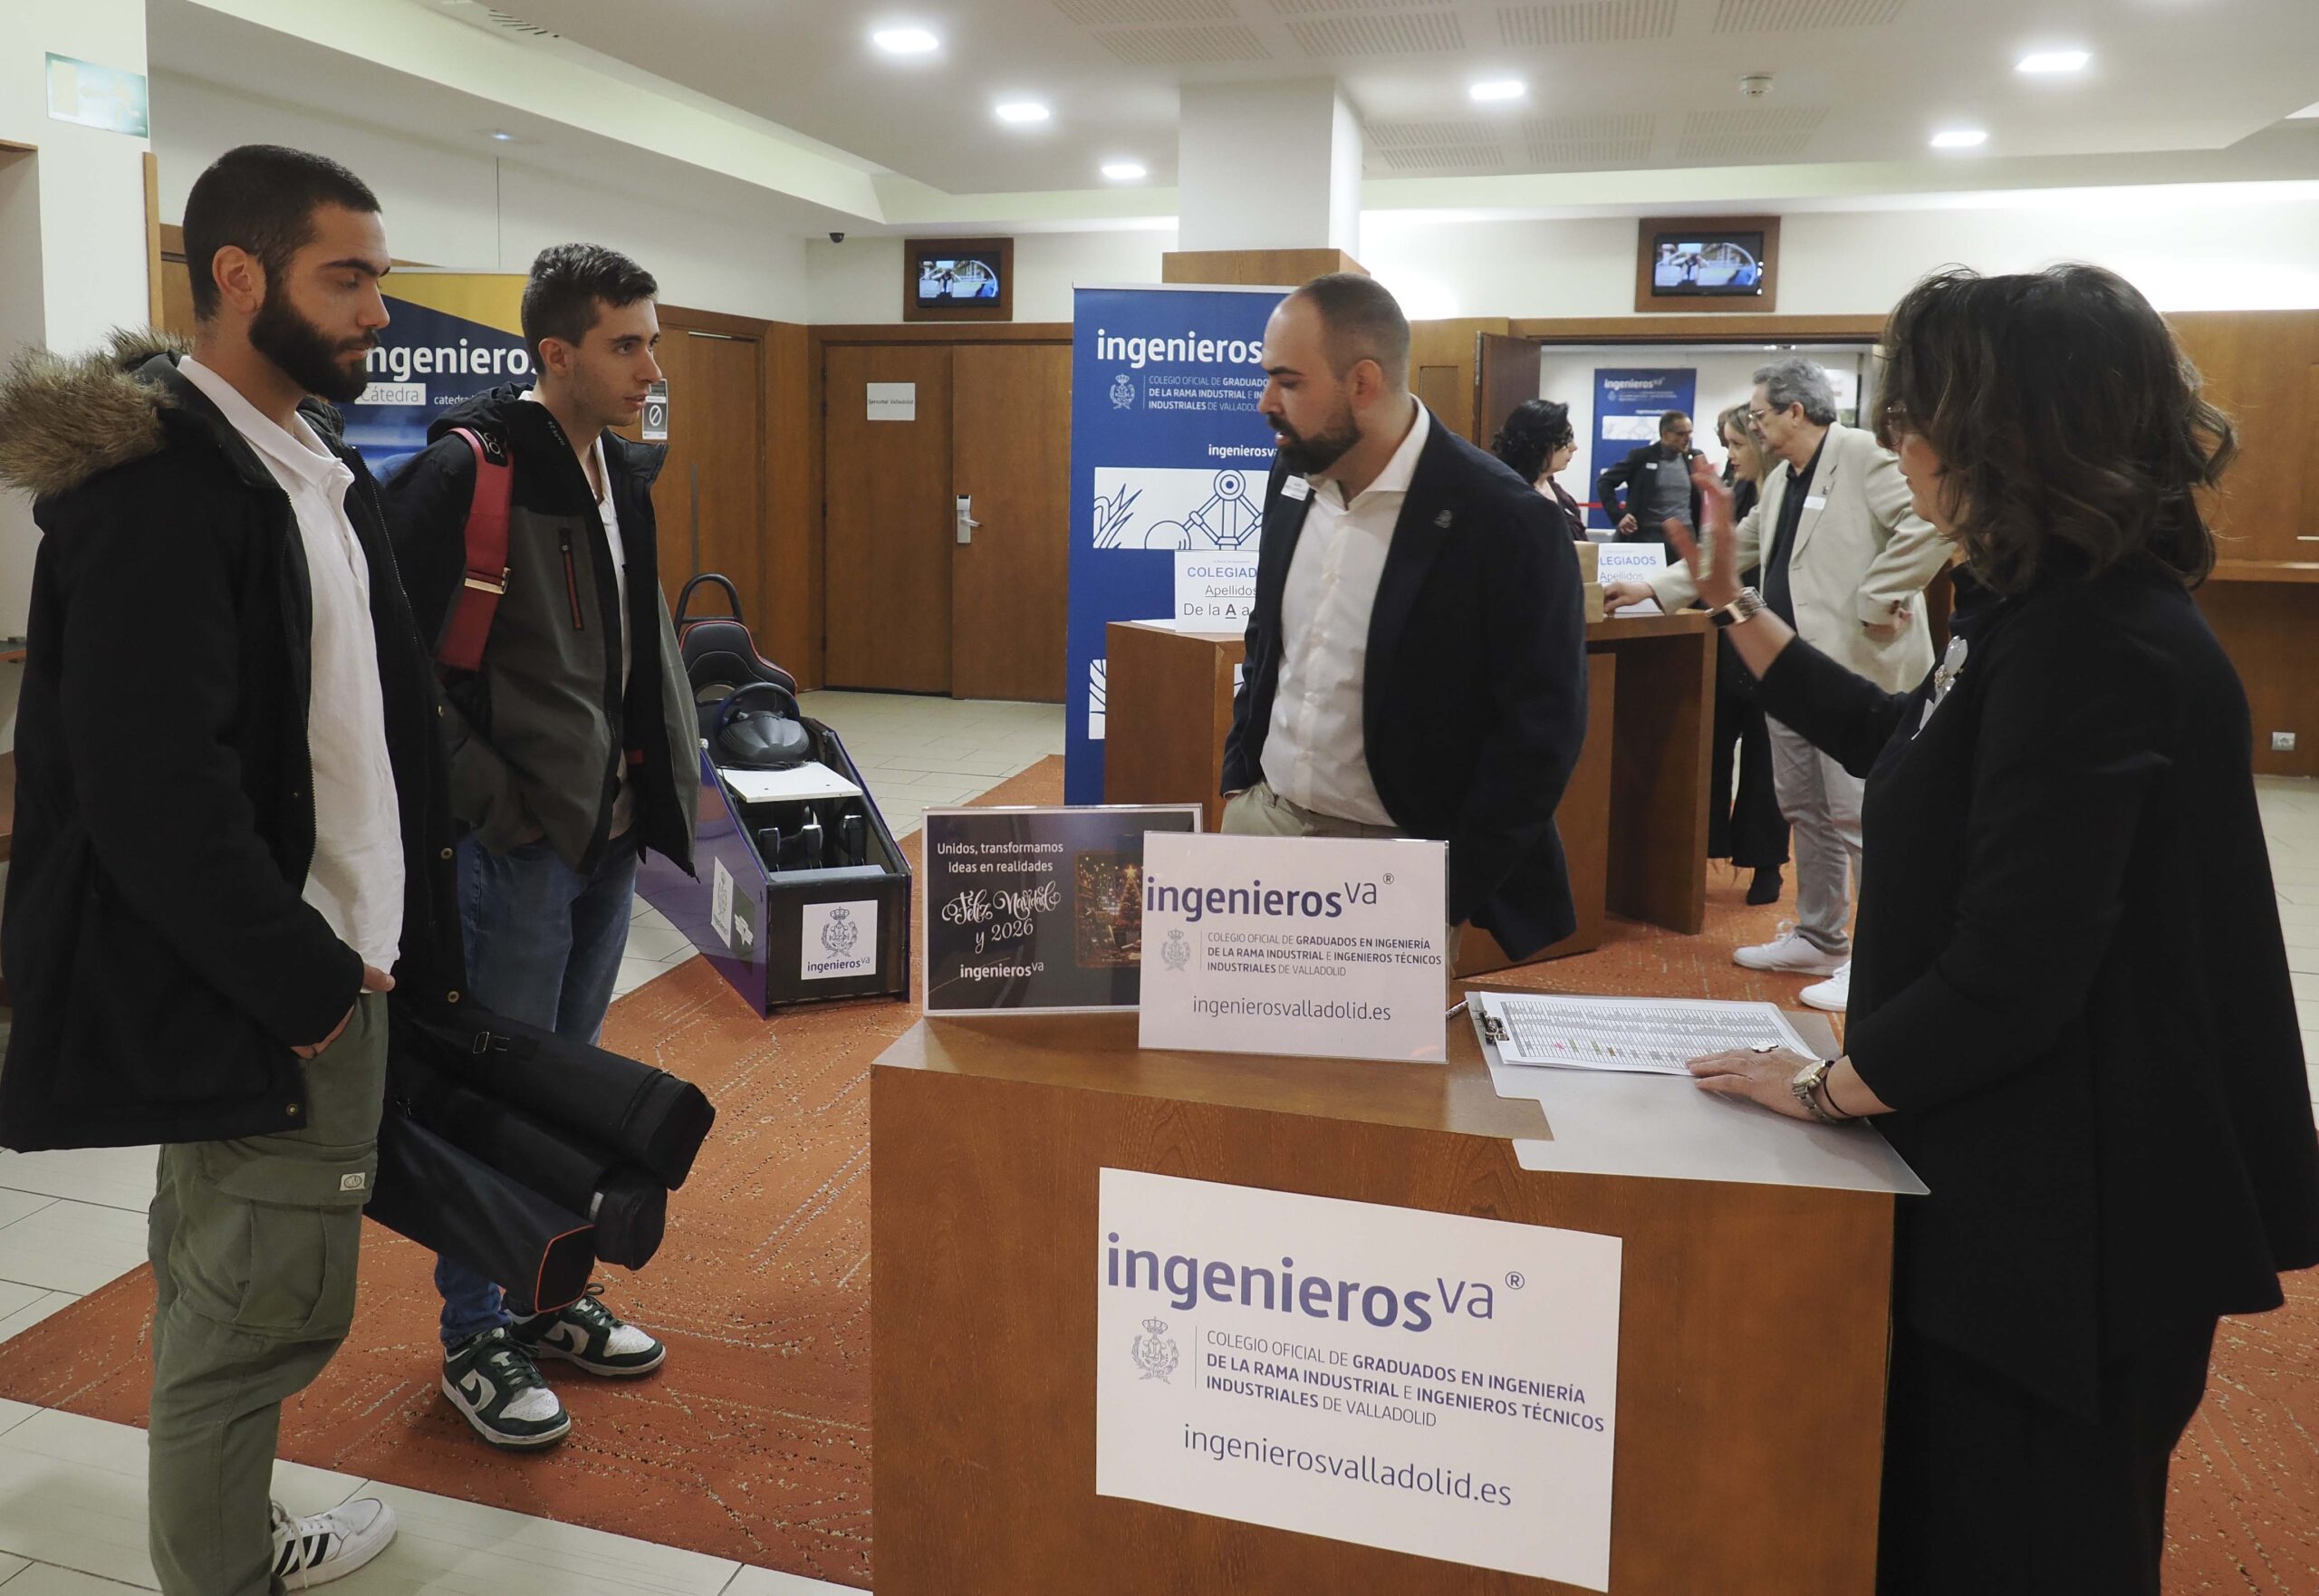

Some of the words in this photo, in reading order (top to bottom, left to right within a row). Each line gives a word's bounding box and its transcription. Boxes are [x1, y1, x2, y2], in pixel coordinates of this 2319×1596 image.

[1097, 329, 1263, 369] ingenieros
[366, 338, 536, 381] ngeniero
[1150, 376, 1180, 385] COLEGIO
[1182, 376, 1209, 385] OFICIAL
[1211, 377, 1221, 386] DE
[1223, 377, 1269, 387] GRADUADO
[1150, 389, 1160, 397] DE
[1161, 389, 1171, 397] LA
[1173, 389, 1197, 398] RAMA
[1198, 389, 1246, 399] INDUSTRIAL
[1248, 390, 1252, 399] E
[1254, 390, 1262, 399] IN
[1149, 400, 1207, 410] INDUSTRIALES
[1208, 402, 1217, 411] DE
[1219, 402, 1259, 411] VALLADOL
[1188, 567, 1257, 578] COLEGIAD
[1205, 584, 1257, 597] Apellidos
[1184, 602, 1203, 616] De
[1208, 602, 1220, 616] la
[1225, 603, 1236, 616] A
[1241, 606, 1250, 616] a
[938, 842, 978, 855] Unidos,
[981, 841, 1063, 854] transformamos
[948, 861, 977, 873] ideas
[979, 862, 994, 872] en
[996, 860, 1054, 872] realidades
[941, 889, 993, 925] Feliz
[992, 880, 1062, 920] Navidad
[975, 931, 985, 954] y
[991, 918, 1034, 941] 2026
[1208, 932, 1246, 943] COLEGIO
[1247, 933, 1280, 944] OFICIAL
[1282, 935, 1294, 945] DE
[1296, 936, 1357, 947] GRADUADOS
[1360, 937, 1372, 947] EN
[1375, 937, 1430, 949] INGENIERÍA
[1208, 947, 1220, 957] DE
[1222, 947, 1234, 957] LA
[1236, 948, 1265, 958] RAMA
[1266, 949, 1324, 960] INDUSTRIAL
[1326, 951, 1333, 961] E
[1334, 952, 1392, 963] INGENIEROS
[1395, 952, 1442, 966] TÉCNICOS
[1208, 962, 1276, 974] INDUSTRIALES
[1278, 965, 1290, 974] DE
[1293, 965, 1346, 976] VALLADOLID
[1193, 995, 1391, 1021] ingenierosvalladolid.es
[1208, 1330, 1268, 1353] COLEGIO
[1272, 1341, 1324, 1363] OFICIAL
[1329, 1351, 1348, 1366] DE
[1352, 1354, 1456, 1383] GRADUADOS
[1461, 1370, 1484, 1388] EN
[1488, 1375, 1585, 1404] INGENIERÍA
[1207, 1353, 1227, 1370] DE
[1231, 1357, 1250, 1373] LA
[1254, 1361, 1299, 1382] RAMA
[1304, 1370, 1399, 1399] INDUSTRIAL
[1404, 1385, 1412, 1399] E
[1417, 1387, 1517, 1417] INGENIEROS
[1522, 1402, 1604, 1433] TÉCNICOS
[1207, 1375, 1318, 1408] INDUSTRIALES
[1323, 1396, 1342, 1412] DE
[1346, 1399, 1437, 1427] VALLADOLID
[1185, 1423, 1512, 1506] ingenierosvalladolid.es
